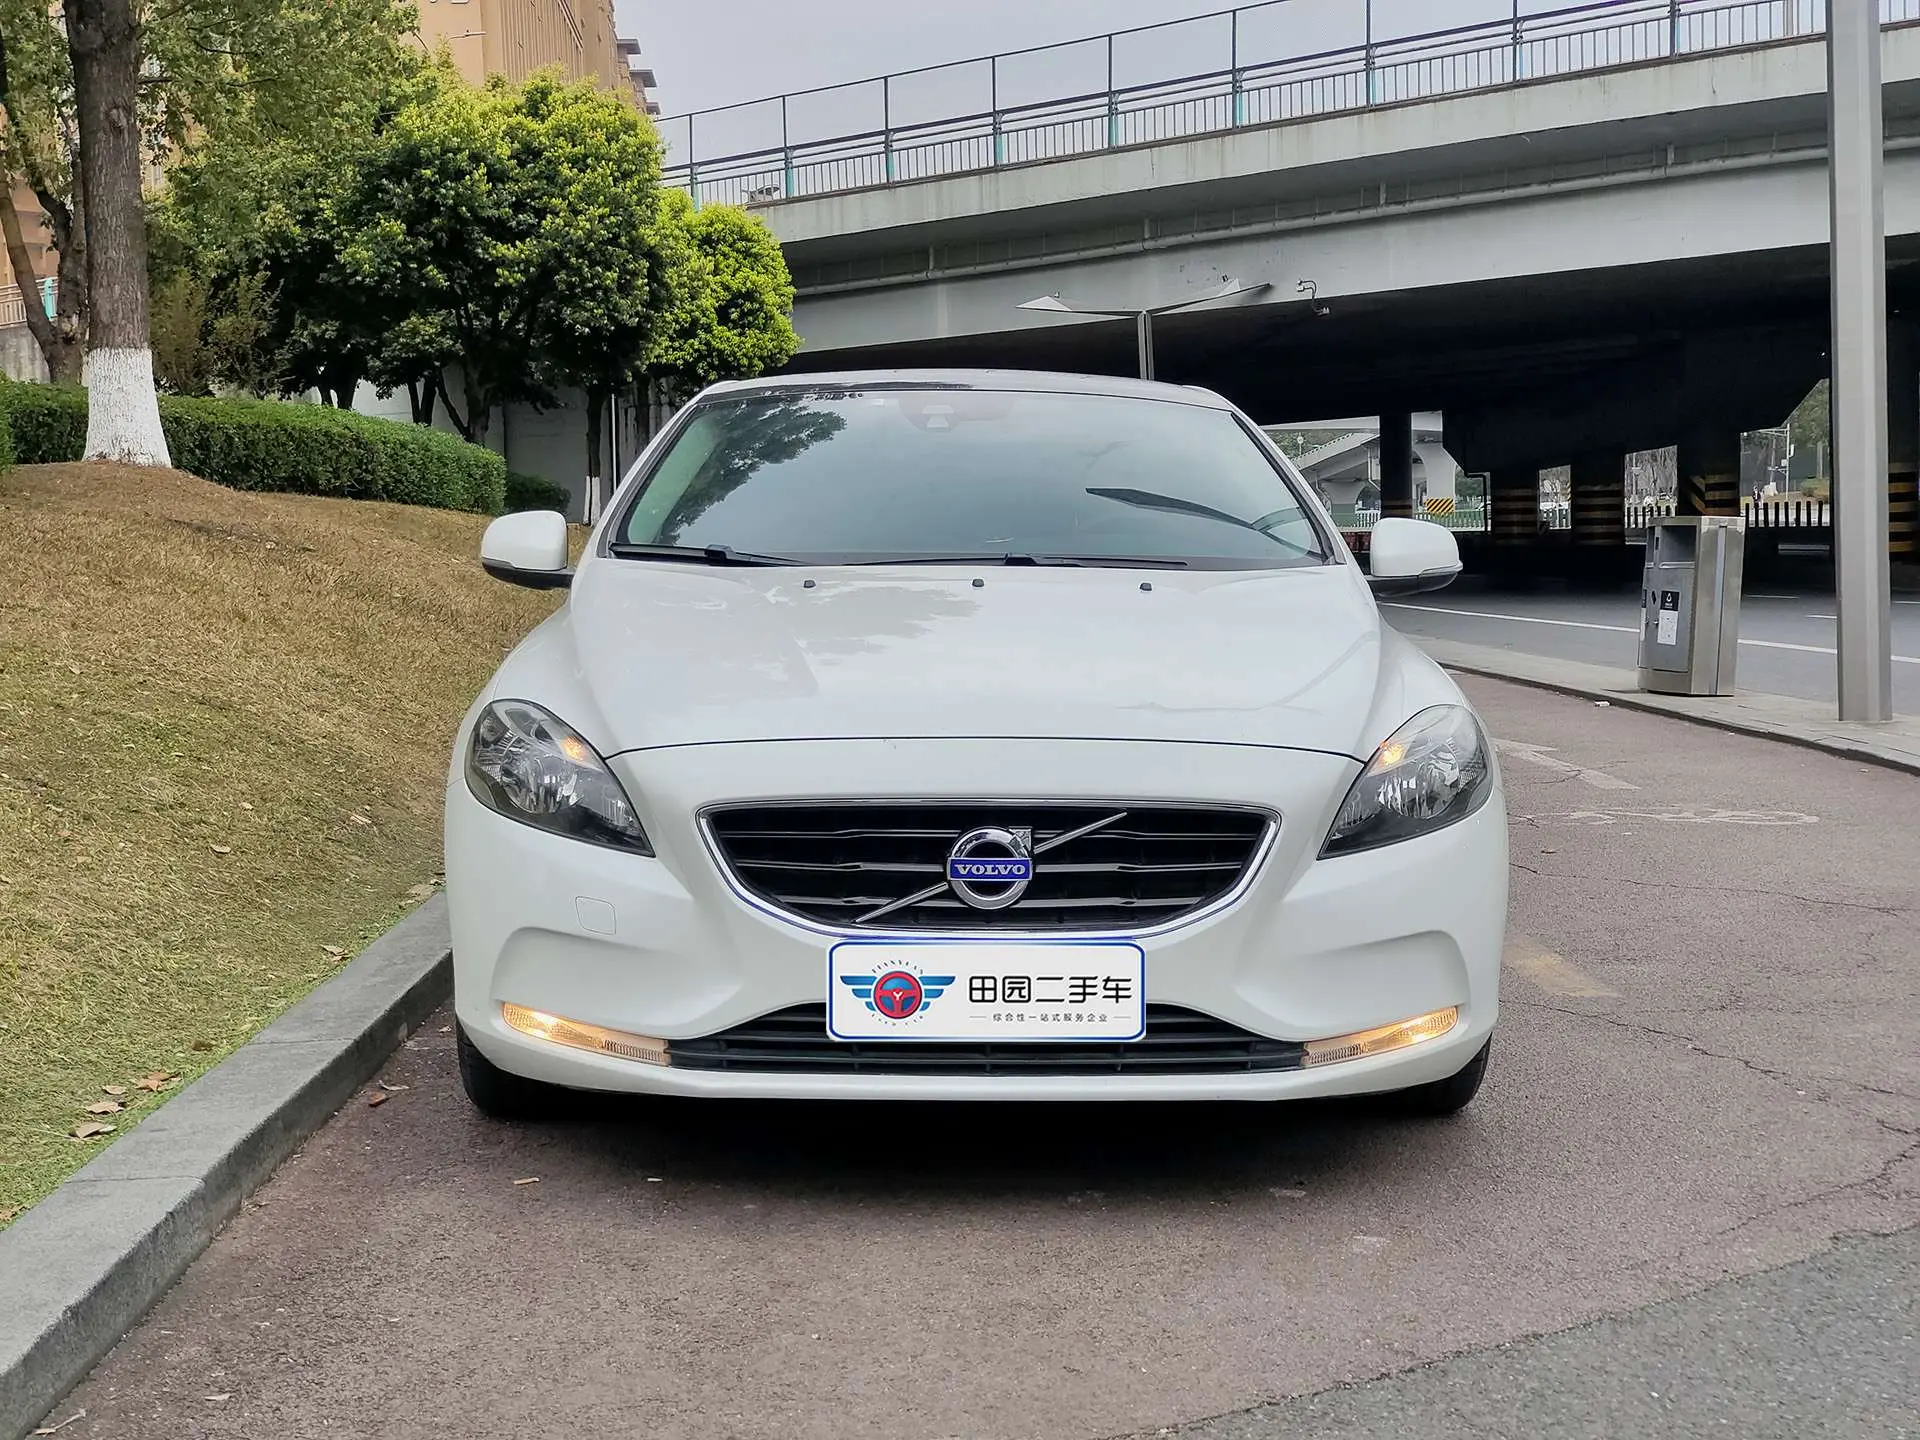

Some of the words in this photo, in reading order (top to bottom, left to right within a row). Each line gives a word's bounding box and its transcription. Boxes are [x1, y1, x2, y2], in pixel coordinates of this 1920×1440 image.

[954, 864, 1026, 875] VOLVO
[969, 975, 1133, 1004] 田园二手车
[992, 1012, 1108, 1023] 综合性一站式服务企业
